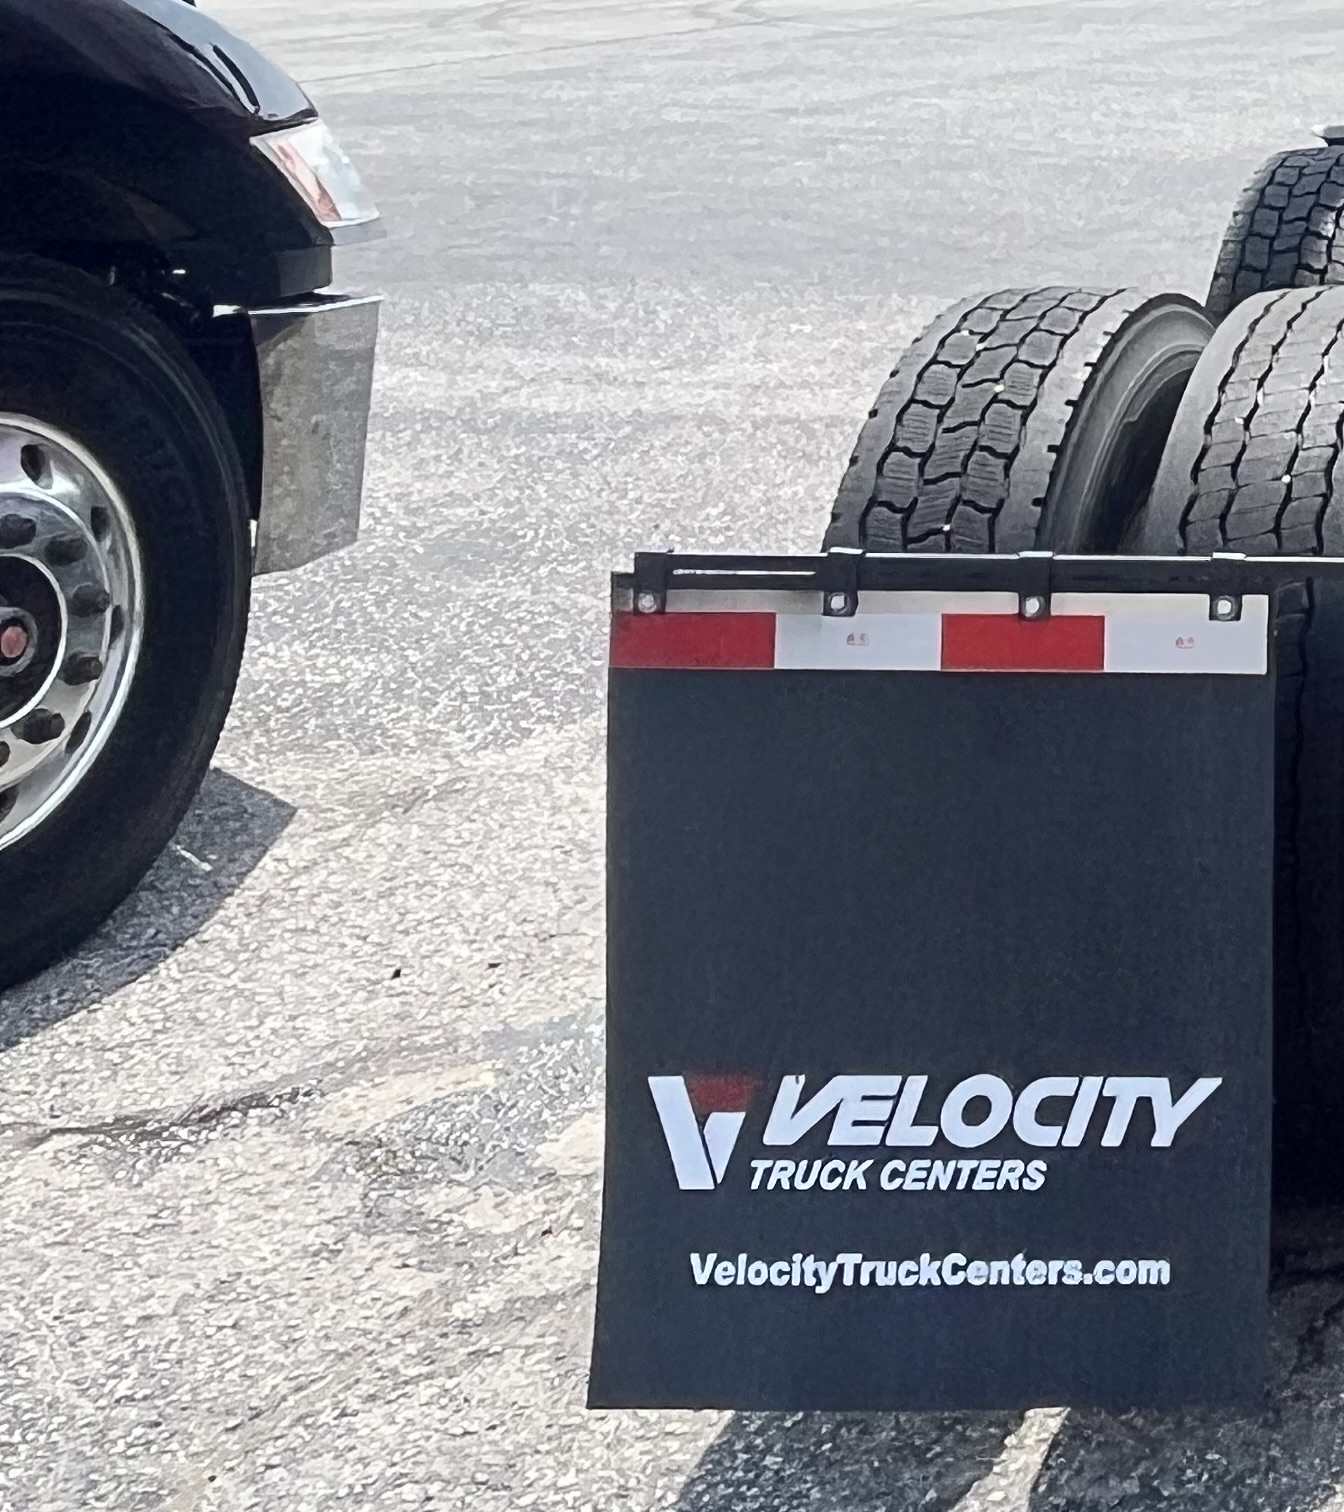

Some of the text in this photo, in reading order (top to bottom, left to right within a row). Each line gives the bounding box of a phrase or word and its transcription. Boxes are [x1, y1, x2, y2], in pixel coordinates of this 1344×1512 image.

[762, 1073, 1223, 1149] VELOCITY
[750, 1158, 1048, 1191] TRUCK CENTERS
[689, 1252, 1171, 1294] VelocityTruckCenters.com
